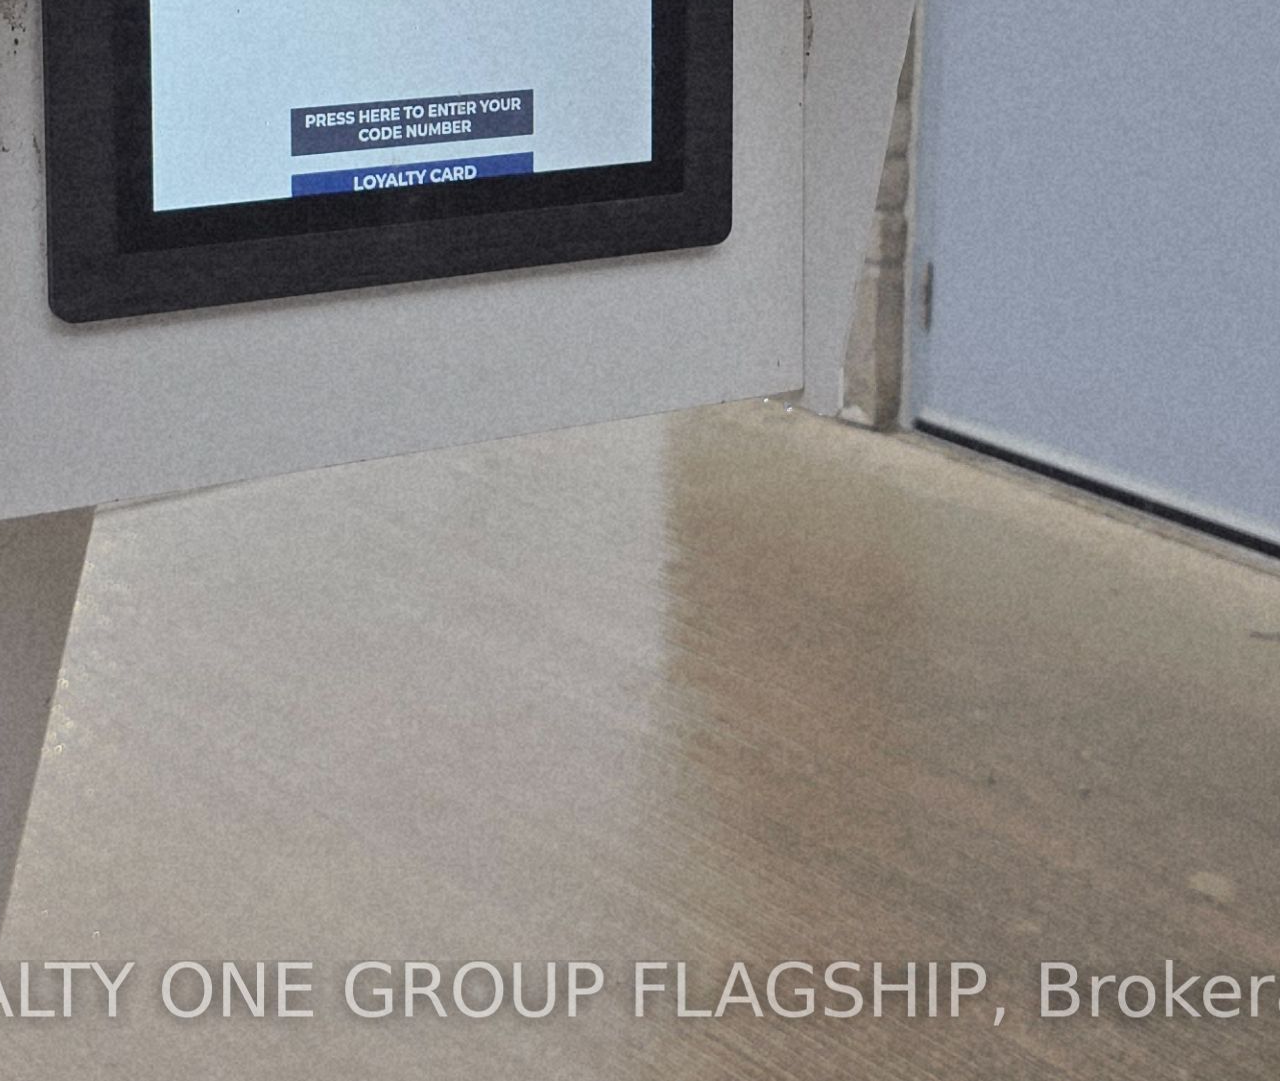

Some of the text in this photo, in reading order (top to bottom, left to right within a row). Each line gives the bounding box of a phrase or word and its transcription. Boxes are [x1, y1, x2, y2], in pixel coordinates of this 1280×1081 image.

[305, 97, 522, 129] PRESS HERE TO ENTER YOUR
[358, 120, 472, 143] CODE NUMBER
[353, 164, 478, 192] LOYALTY CARD
